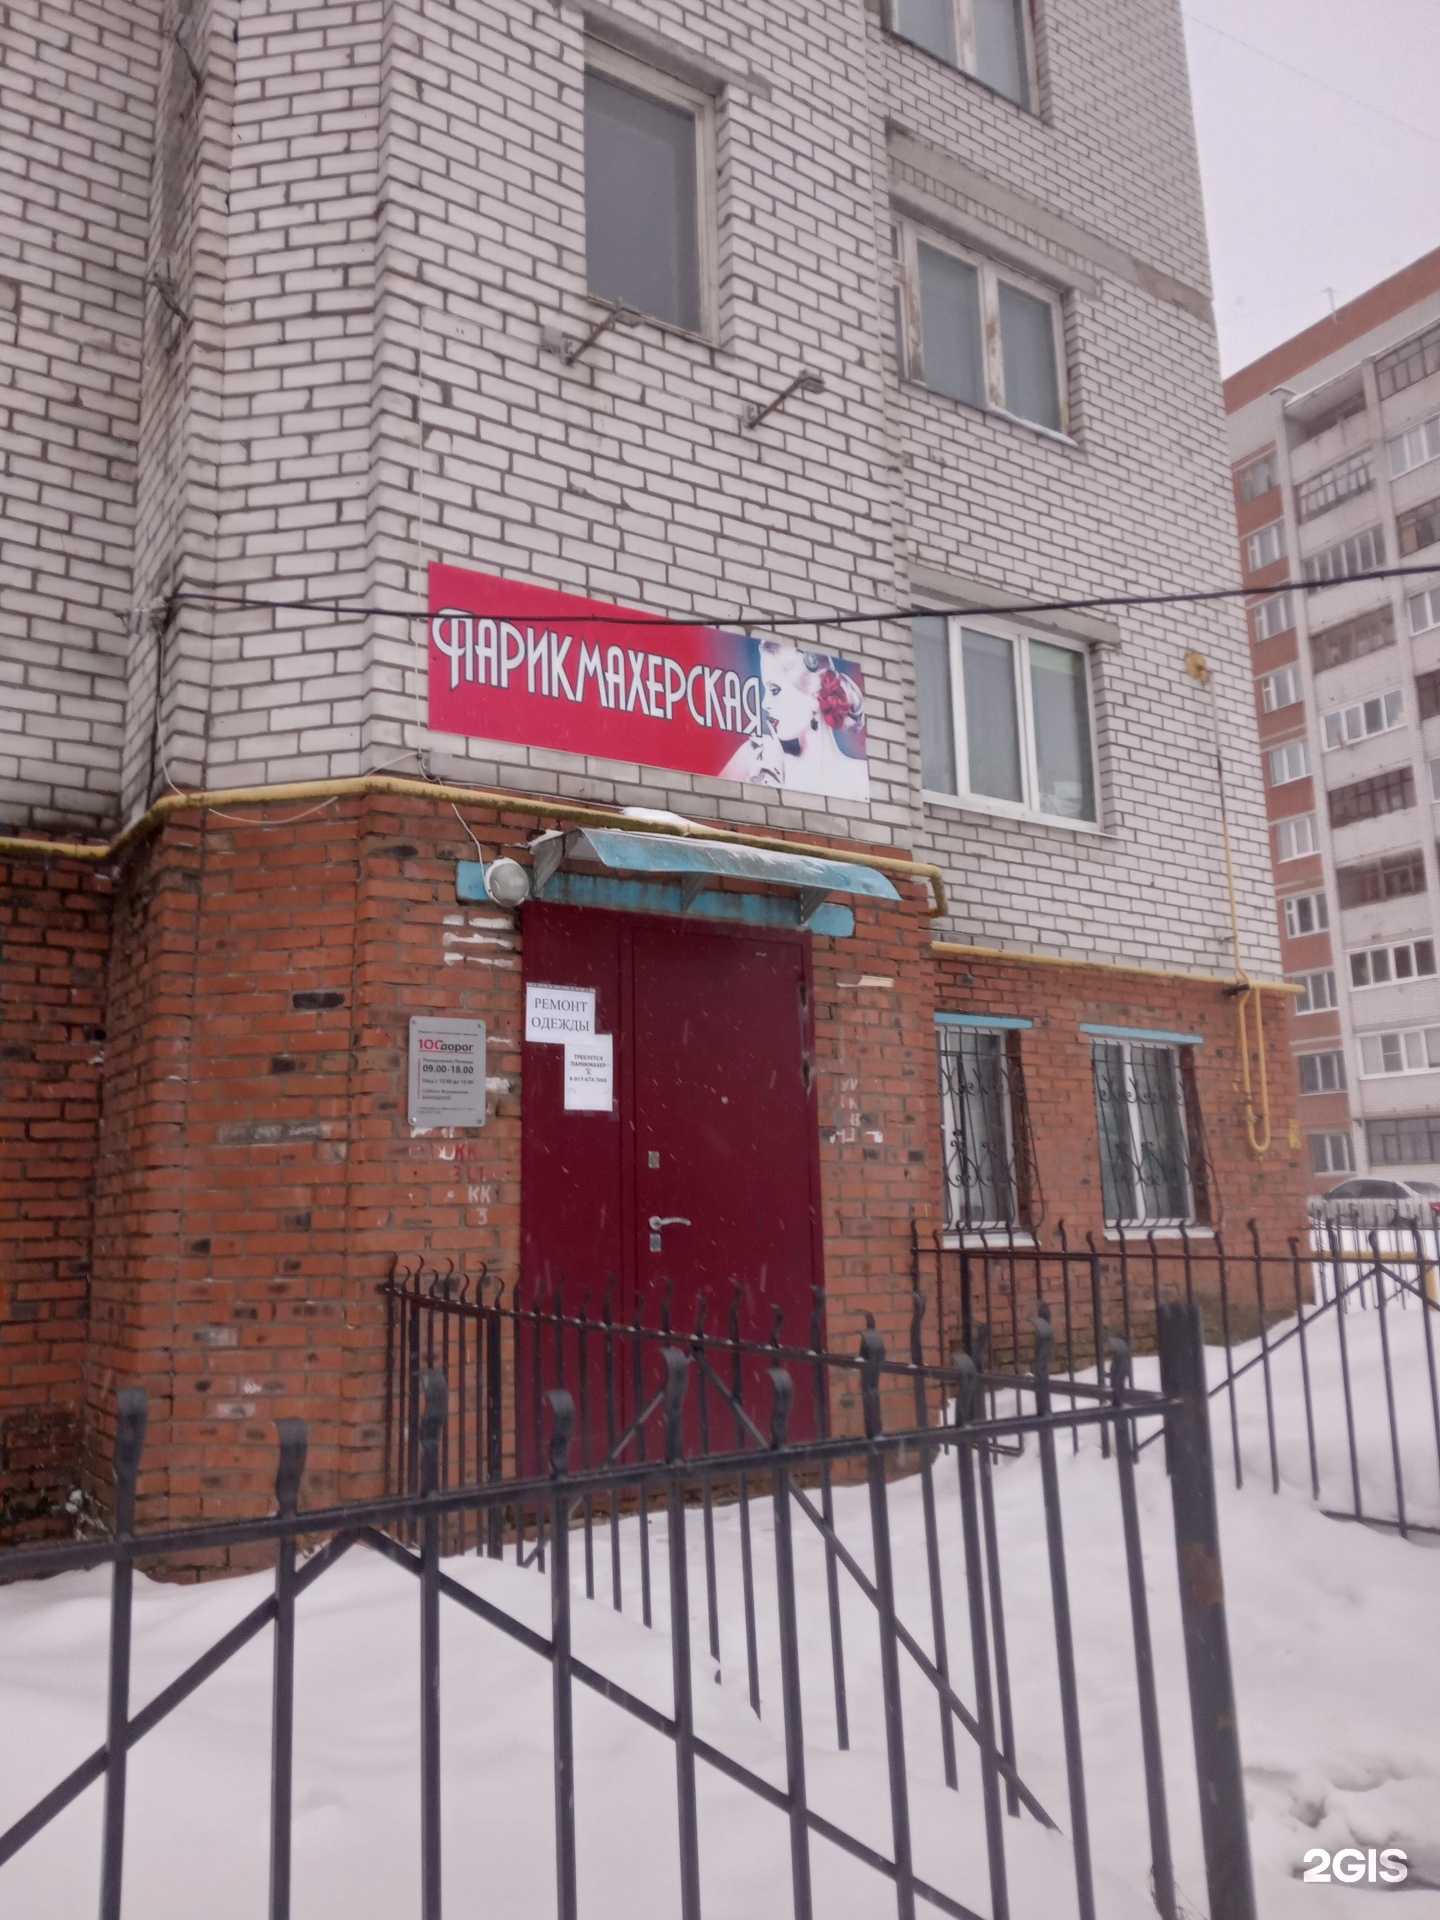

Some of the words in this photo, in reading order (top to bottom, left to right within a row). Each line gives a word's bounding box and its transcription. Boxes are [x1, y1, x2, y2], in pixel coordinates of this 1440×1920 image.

[431, 608, 763, 738] ПАРИКМАХЕРСКАЯ
[534, 997, 588, 1013] РЕМОНТ
[531, 1016, 590, 1033] ОДЕЖДЫ
